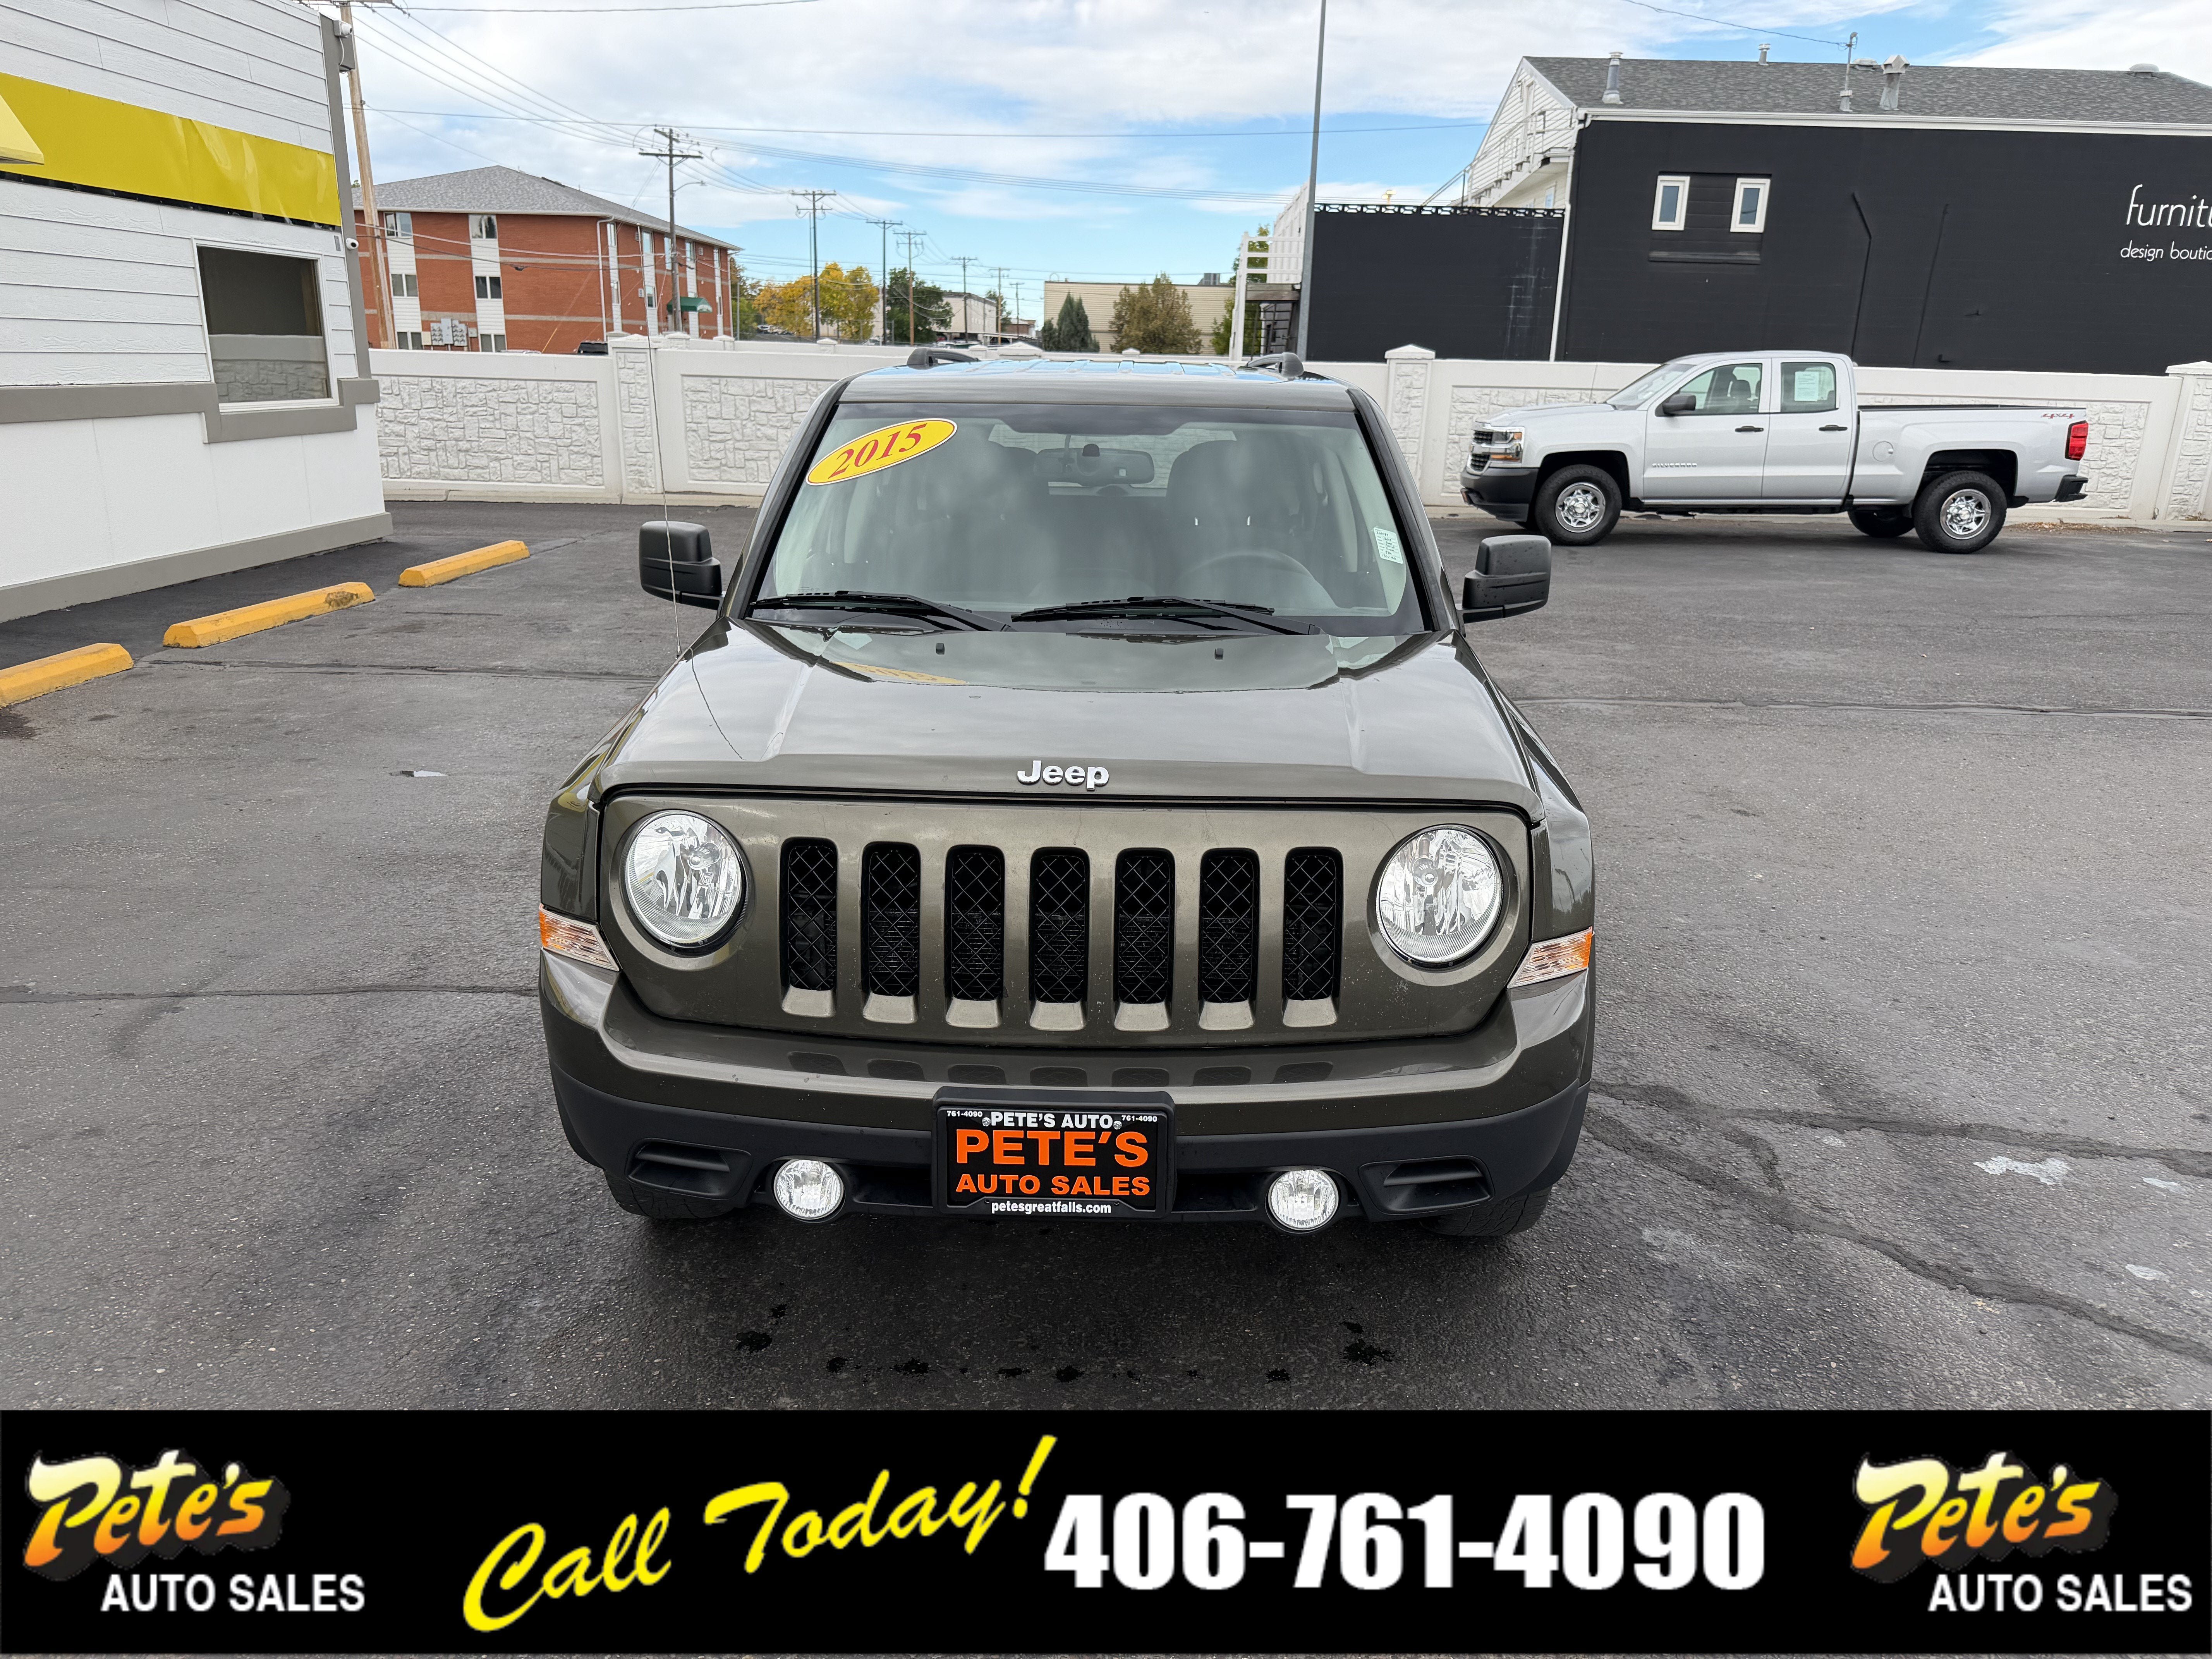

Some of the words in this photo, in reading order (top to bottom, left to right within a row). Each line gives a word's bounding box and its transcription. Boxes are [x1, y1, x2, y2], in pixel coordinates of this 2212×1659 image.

[2126, 184, 2212, 228] furnit
[2120, 240, 2164, 262] design
[828, 423, 928, 479] 2015
[1017, 760, 1109, 791] Jeep
[991, 1111, 1056, 1128] PETE'S
[1061, 1114, 1113, 1129] AUTO
[957, 1129, 1148, 1167] PETE'S
[956, 1174, 1040, 1194] AUTO
[1051, 1175, 1150, 1195] SALES
[991, 1200, 1111, 1215] petesgreatfalls.com
